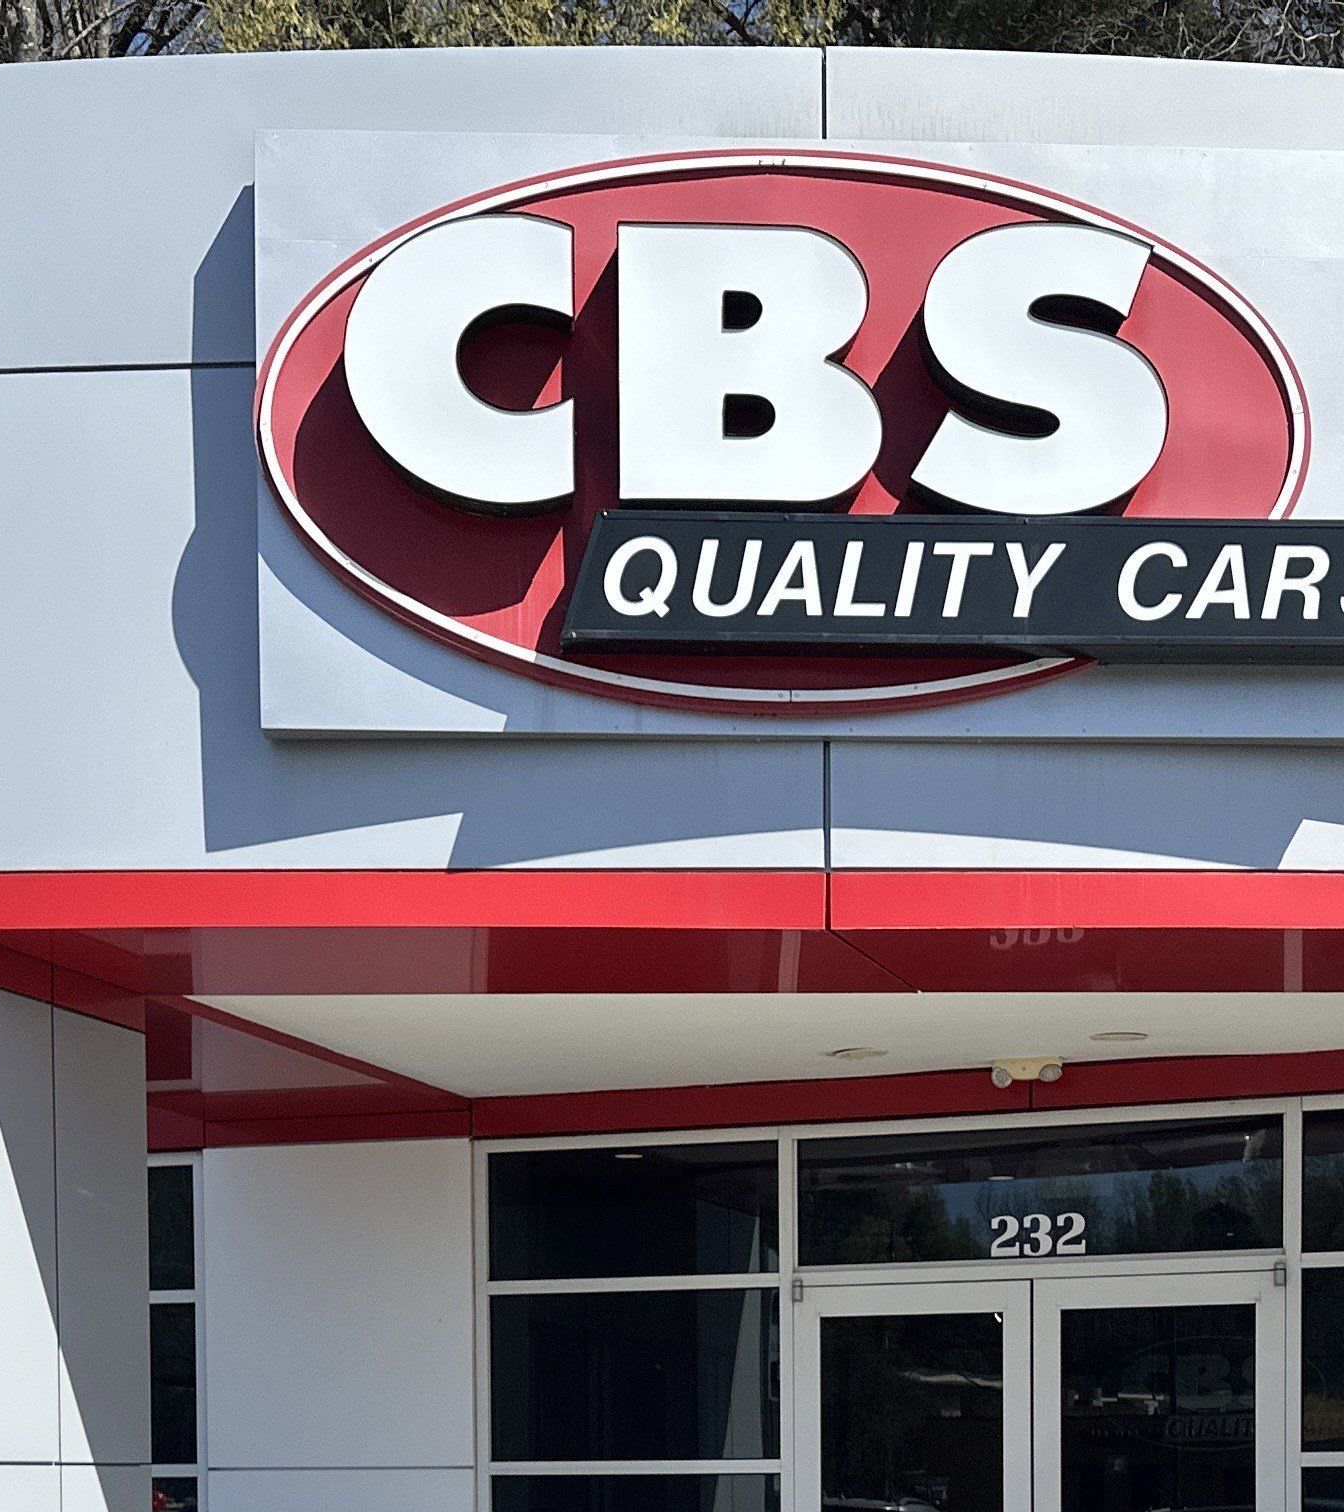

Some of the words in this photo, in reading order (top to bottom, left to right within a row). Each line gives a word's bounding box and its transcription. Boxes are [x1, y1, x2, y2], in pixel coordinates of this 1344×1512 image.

[343, 212, 1169, 516] CBS
[602, 536, 1067, 619] QUALITY
[990, 1212, 1086, 1257] 232
